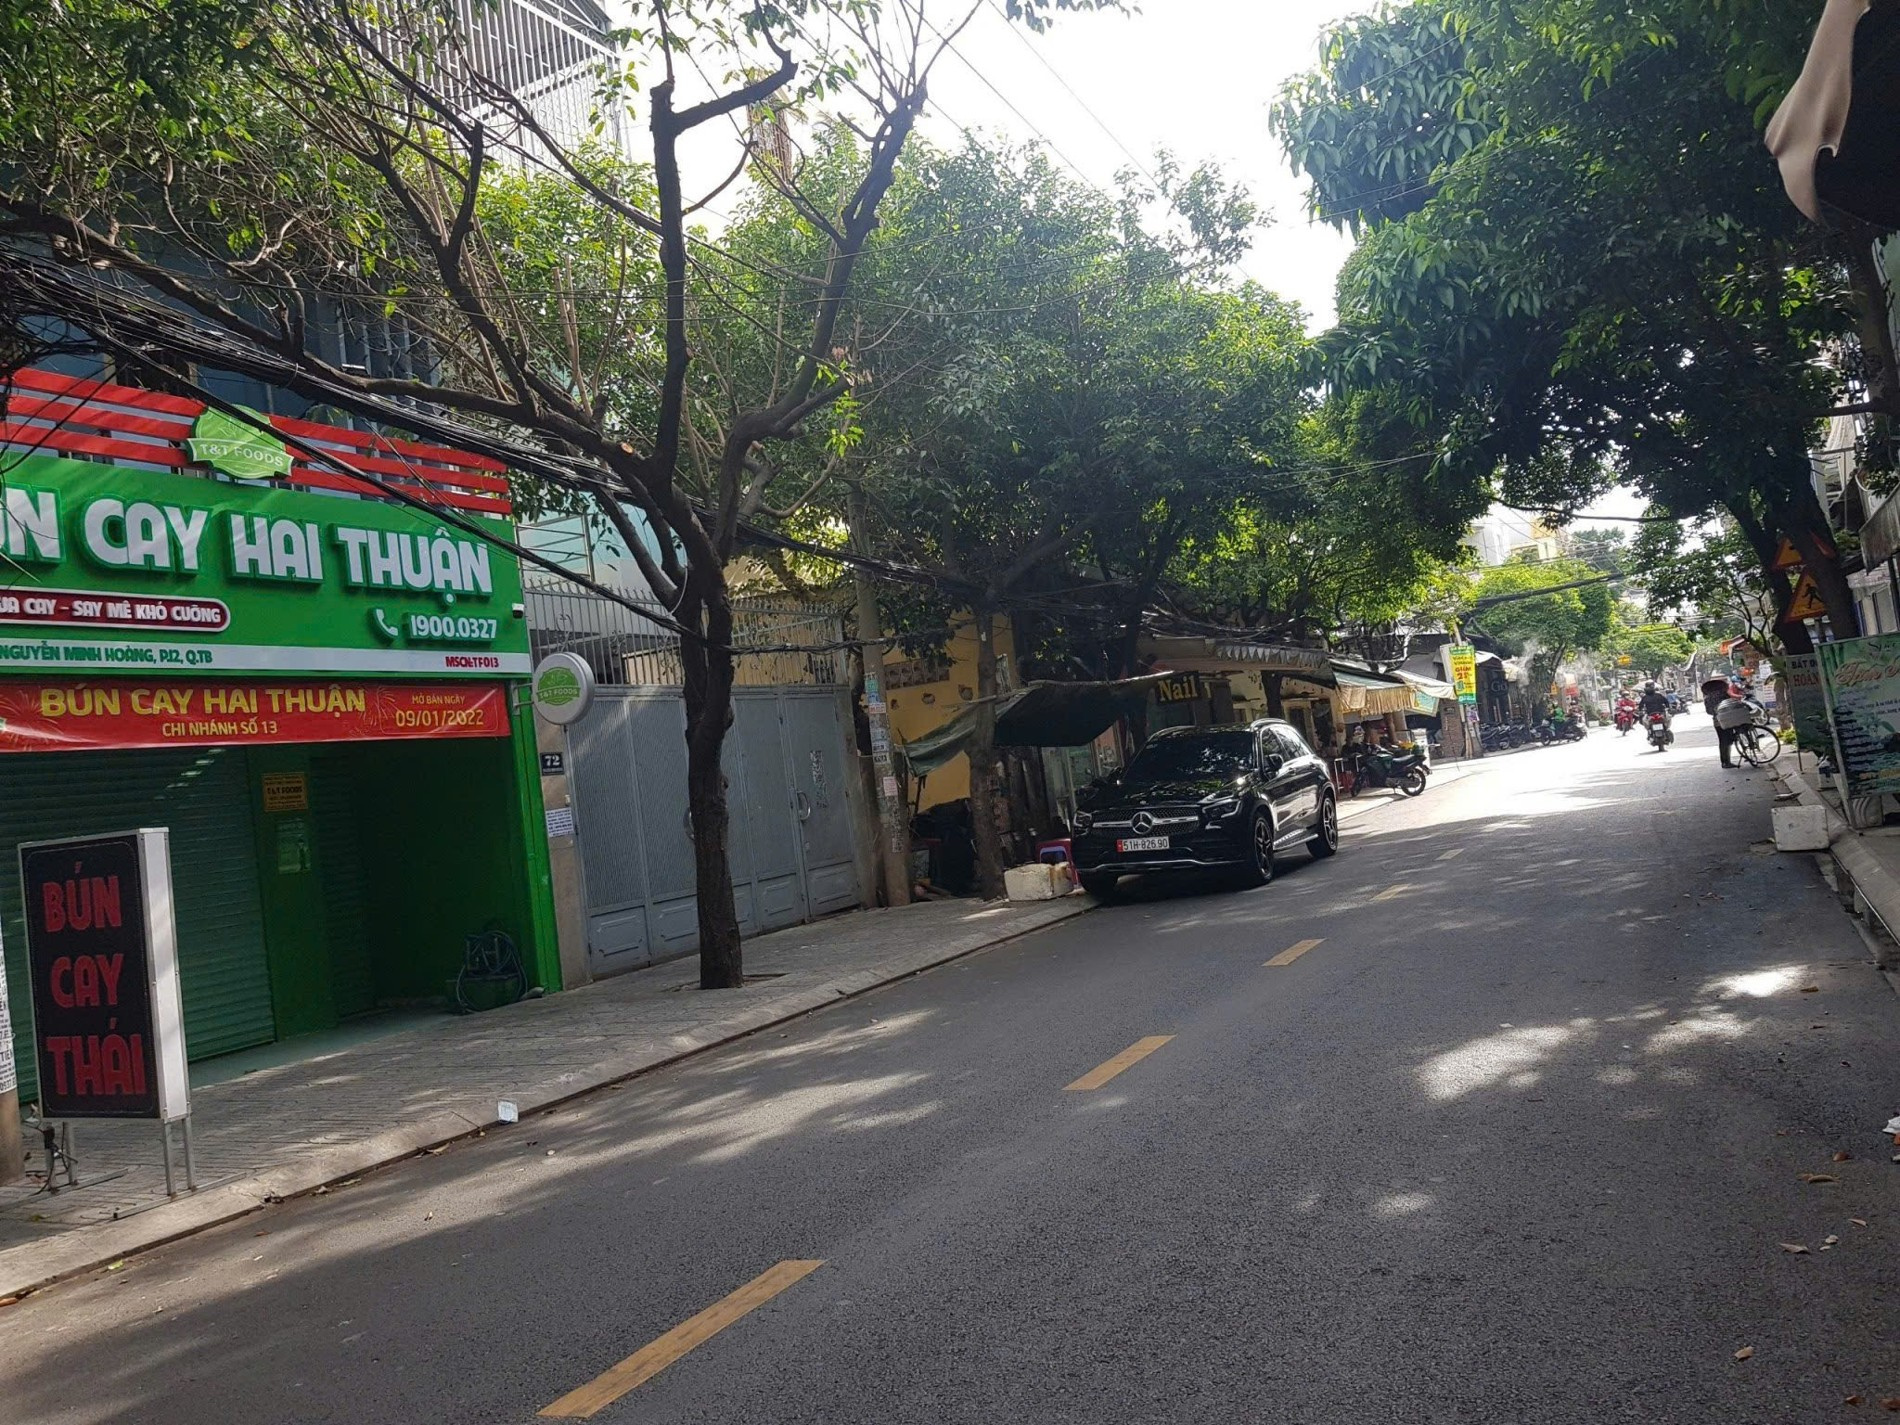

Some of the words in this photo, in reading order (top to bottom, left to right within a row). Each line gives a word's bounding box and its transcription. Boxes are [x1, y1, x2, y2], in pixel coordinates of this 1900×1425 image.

[200, 443, 228, 456] T&T
[234, 446, 284, 467] FOODS
[84, 498, 208, 571] CAY
[230, 513, 323, 580] HAI
[337, 526, 493, 603] THUẬN
[23, 597, 57, 615] CAY
[72, 600, 103, 618] SAY
[106, 600, 133, 619] MÊ
[135, 601, 168, 620] KHÓ
[410, 614, 497, 639] 1900.0327
[64, 646, 102, 661] MINH
[185, 649, 213, 665] Q.TB
[41, 682, 121, 717] BÚN
[131, 687, 194, 715] CAY
[203, 688, 259, 714] HAI
[265, 683, 366, 718] THUẬN
[1158, 675, 1198, 701] Nail
[162, 721, 186, 737] CHI
[188, 718, 239, 736] NHÁNH
[240, 716, 259, 735] SỐ
[261, 720, 278, 735] 13
[396, 709, 484, 727] 09/01/2022
[544, 755, 561, 767] 72
[43, 860, 122, 933] BÚN
[51, 952, 124, 1008] CAY
[46, 1017, 148, 1096] THÁI
